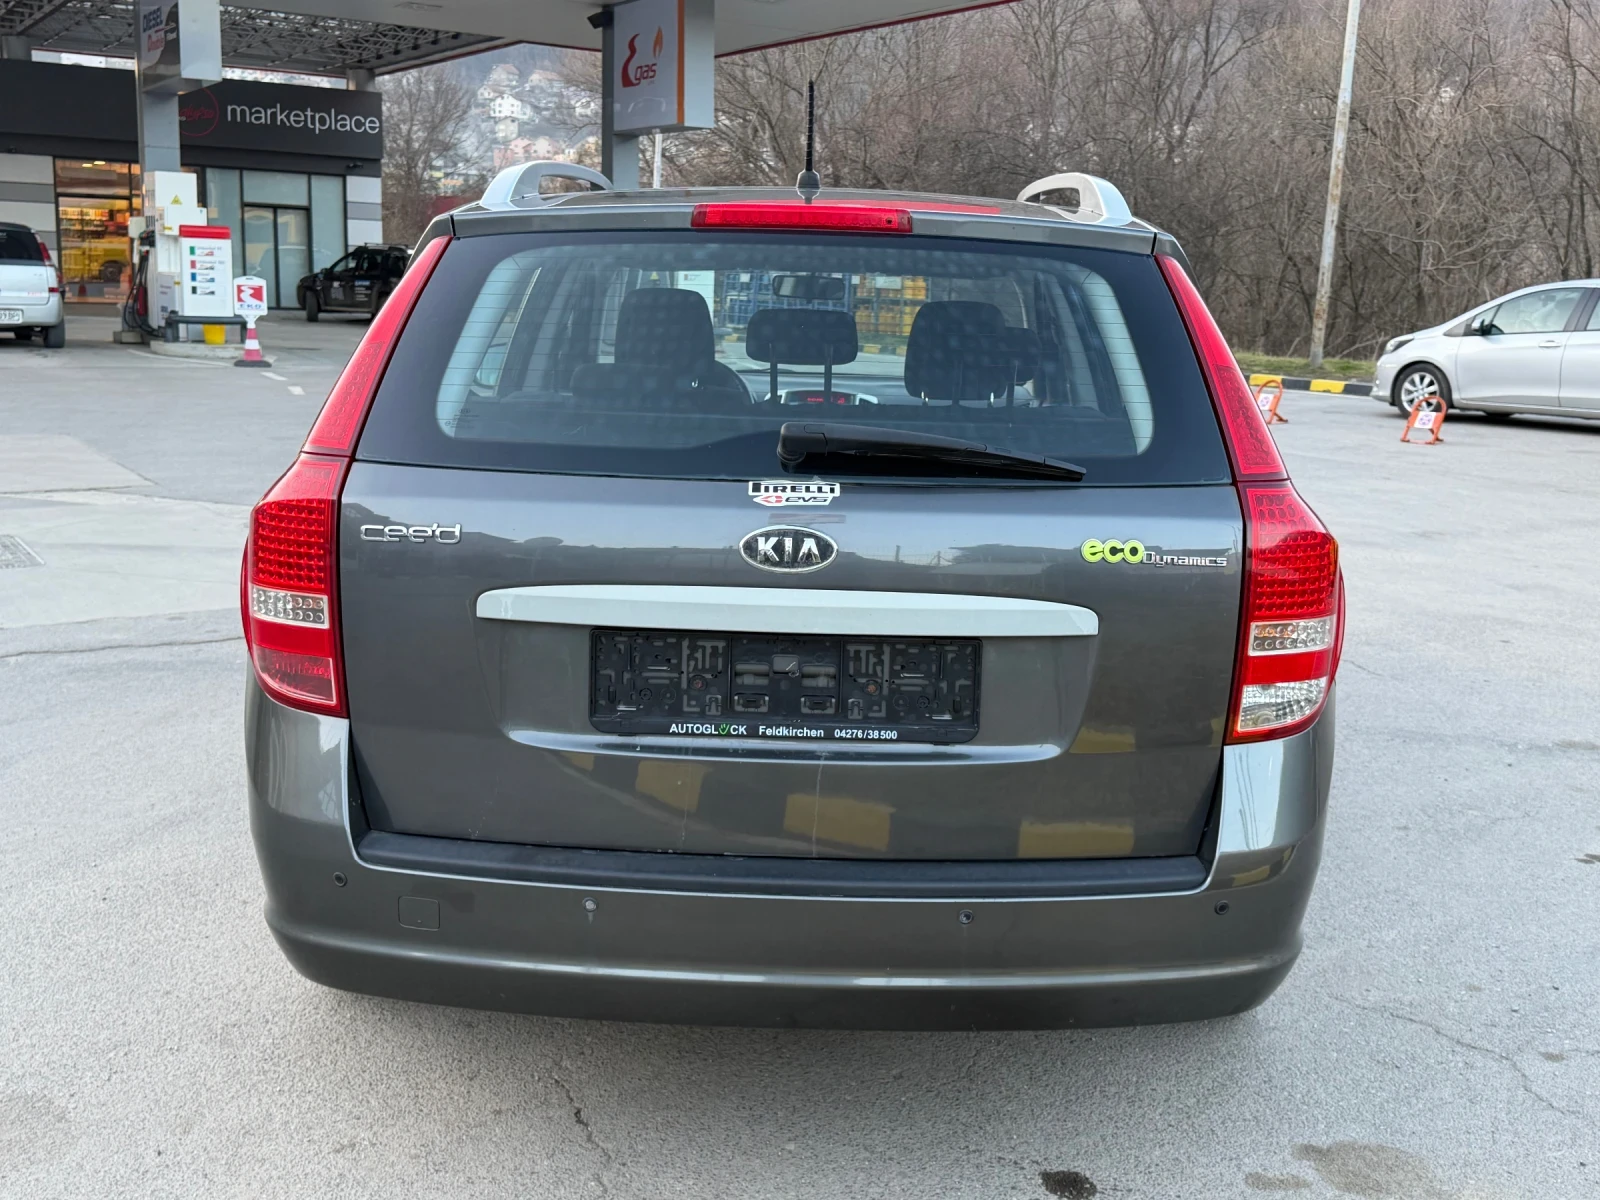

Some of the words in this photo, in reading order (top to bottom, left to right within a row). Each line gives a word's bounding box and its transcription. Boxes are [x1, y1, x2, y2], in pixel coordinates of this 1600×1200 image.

[227, 103, 380, 134] marketplace
[752, 482, 836, 494] PIRELLI
[360, 522, 462, 544] cee'd
[757, 536, 821, 563] KIA
[759, 725, 824, 738] Feldkirchen
